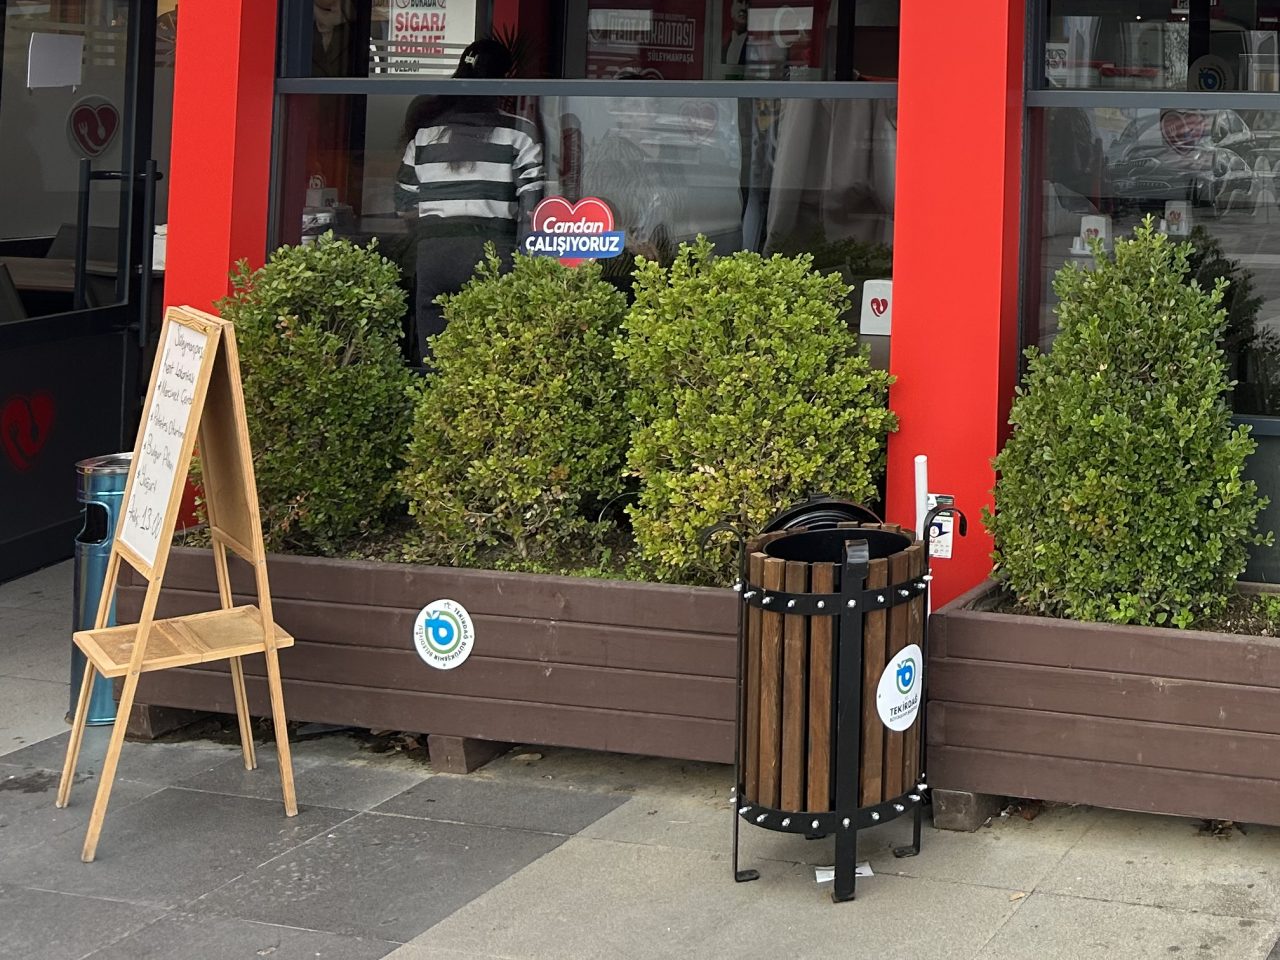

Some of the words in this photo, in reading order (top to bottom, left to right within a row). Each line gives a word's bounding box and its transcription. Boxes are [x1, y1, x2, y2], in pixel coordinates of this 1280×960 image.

[395, 34, 445, 54] İÇİLME
[543, 216, 603, 234] Candan
[525, 236, 620, 256] ÇALIŞIYORUZ
